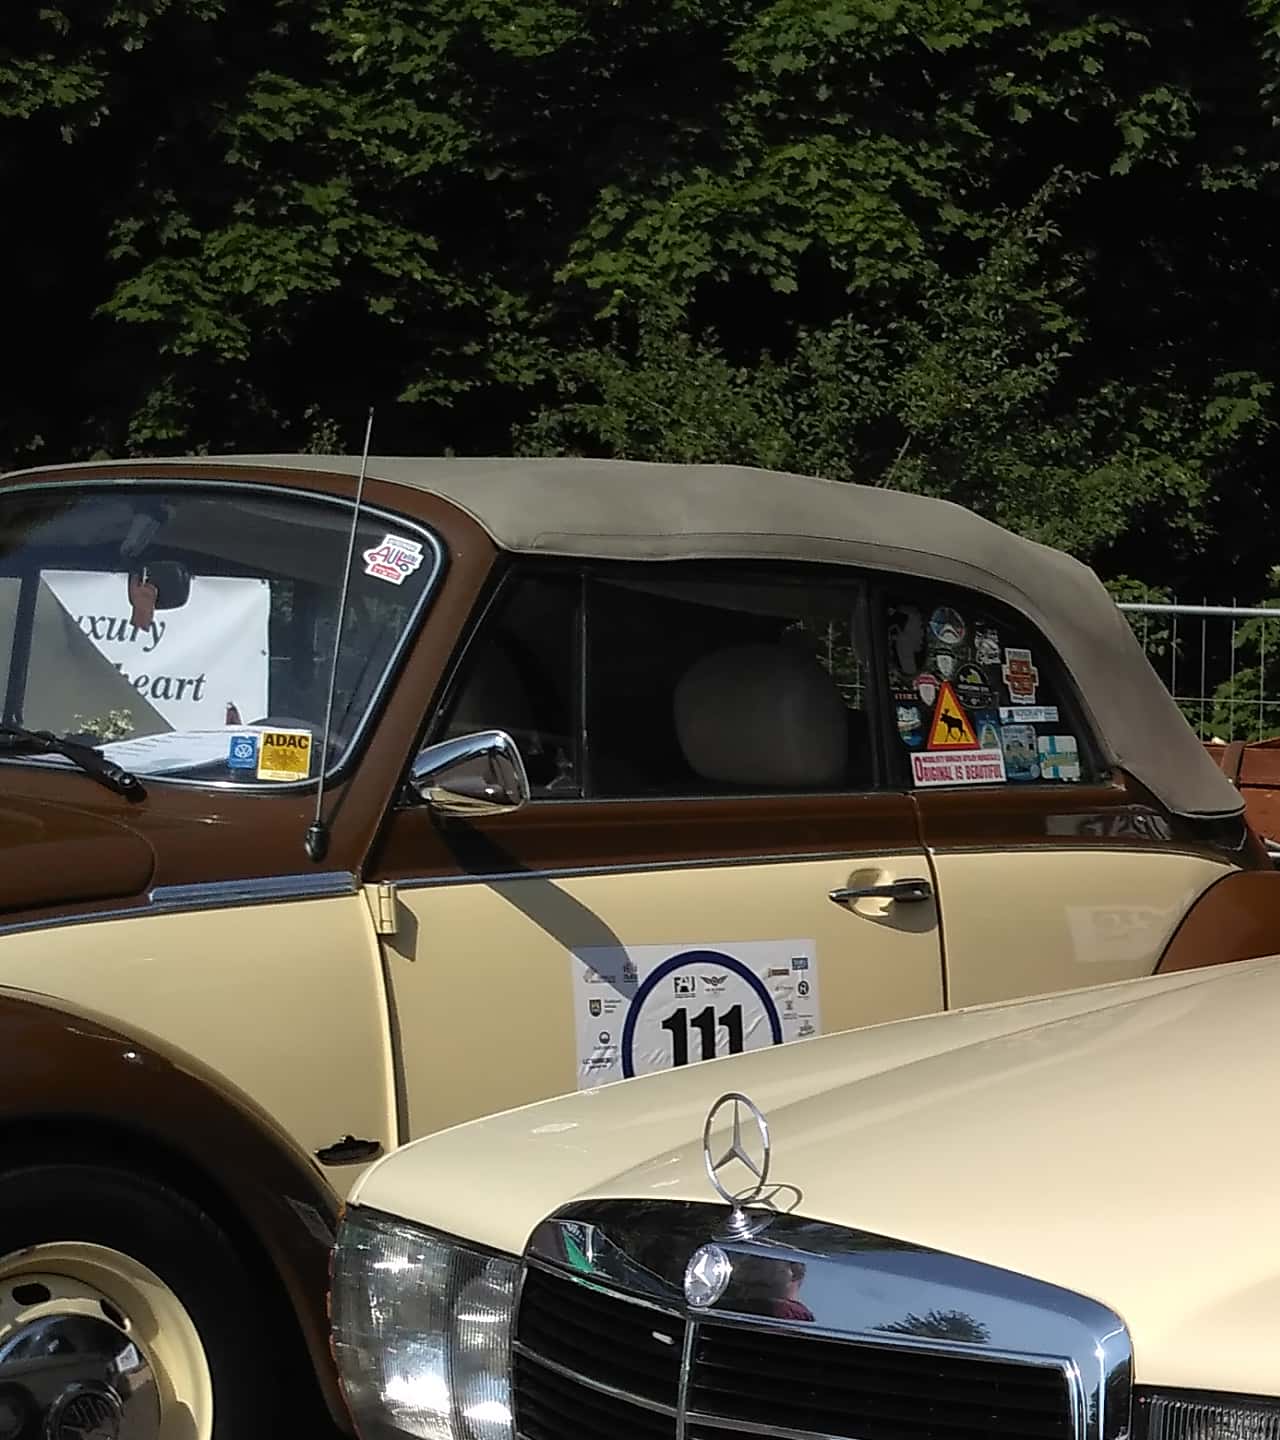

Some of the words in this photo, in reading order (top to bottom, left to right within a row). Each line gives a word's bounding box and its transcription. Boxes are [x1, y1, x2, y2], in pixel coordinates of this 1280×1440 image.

[112, 662, 206, 701] eart
[263, 733, 310, 750] ADAC
[661, 1004, 744, 1067] 111
